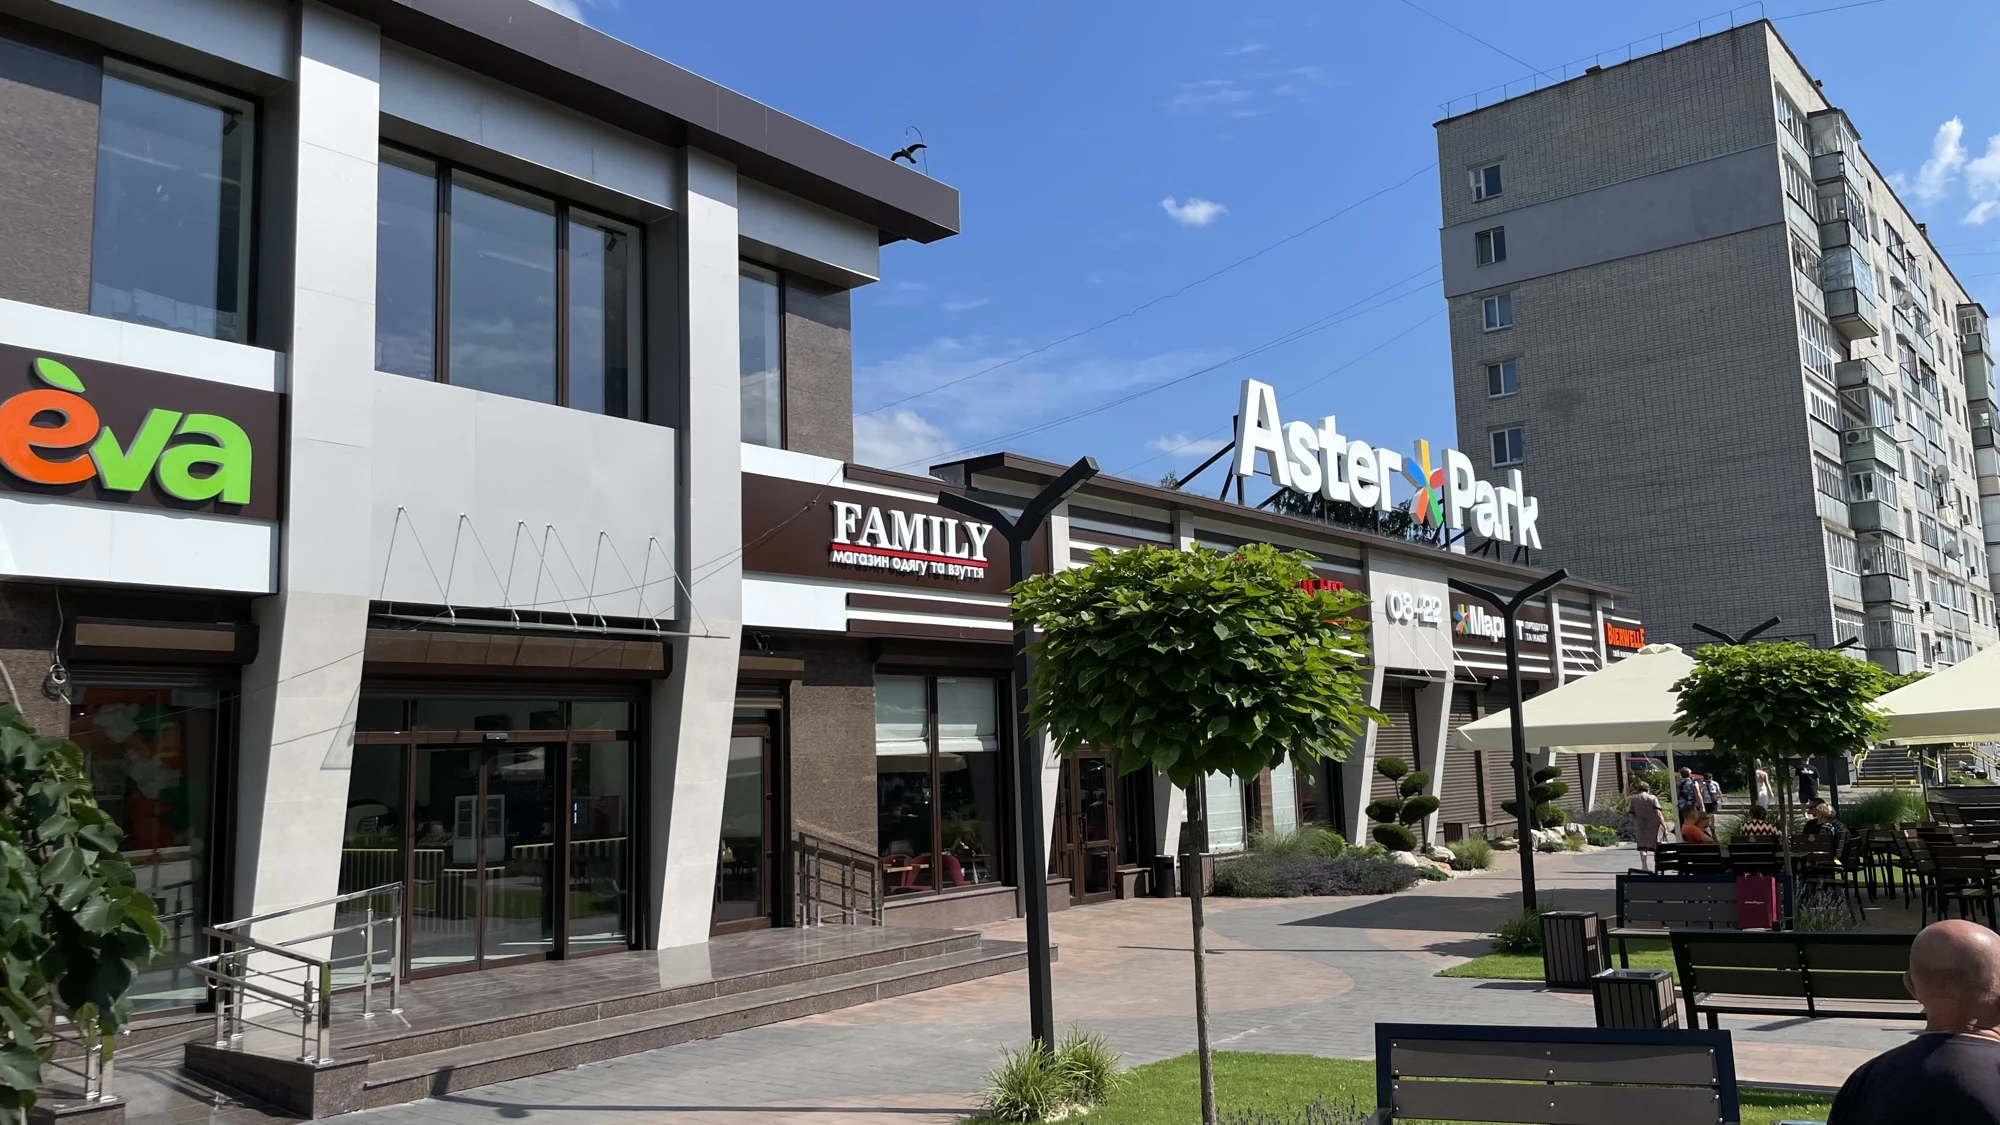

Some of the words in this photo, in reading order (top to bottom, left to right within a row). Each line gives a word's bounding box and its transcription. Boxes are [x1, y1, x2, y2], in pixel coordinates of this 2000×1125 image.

[1233, 378, 1402, 512] Aster
[1441, 448, 1542, 549] Park
[831, 500, 993, 561] FAMILY
[831, 550, 889, 569] магазин
[892, 557, 928, 576] одягу
[930, 562, 945, 575] та
[949, 566, 984, 580] взуття
[1386, 590, 1443, 623] 08-22
[1467, 604, 1524, 642] Март
[1606, 622, 1645, 648] BIERWELLE
